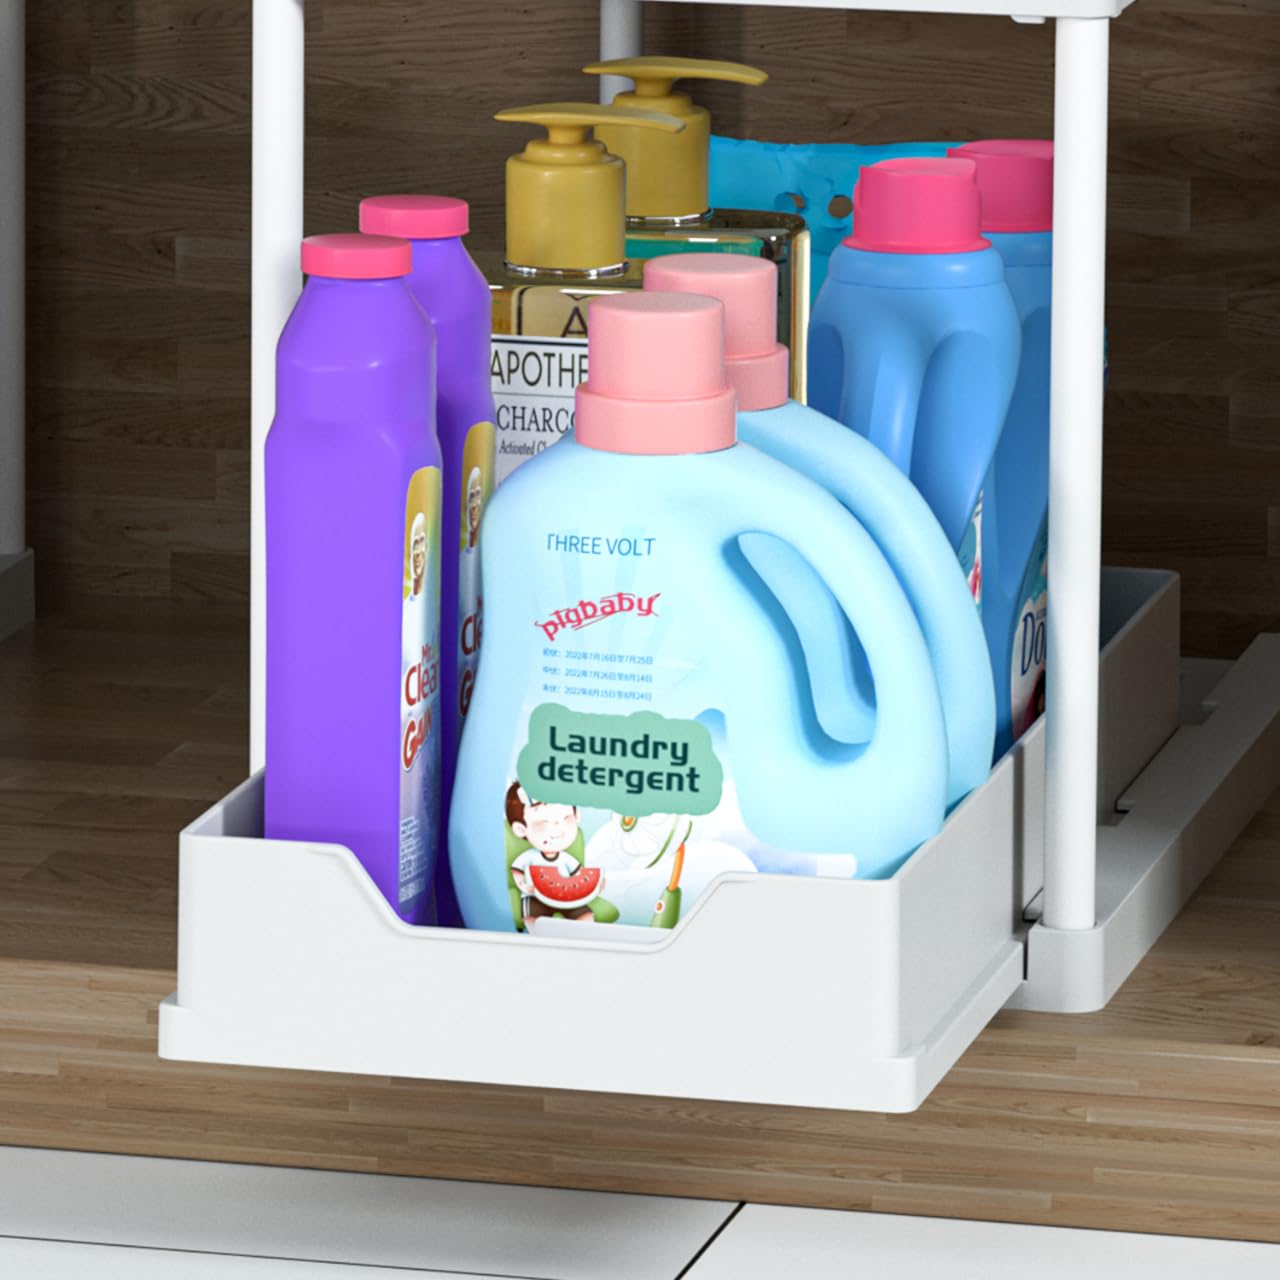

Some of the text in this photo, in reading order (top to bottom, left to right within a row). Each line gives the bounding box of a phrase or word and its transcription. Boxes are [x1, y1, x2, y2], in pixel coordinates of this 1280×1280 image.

[547, 533, 657, 556] THREE VOLT
[549, 725, 689, 767] Laundry
[537, 754, 700, 795] detergent
